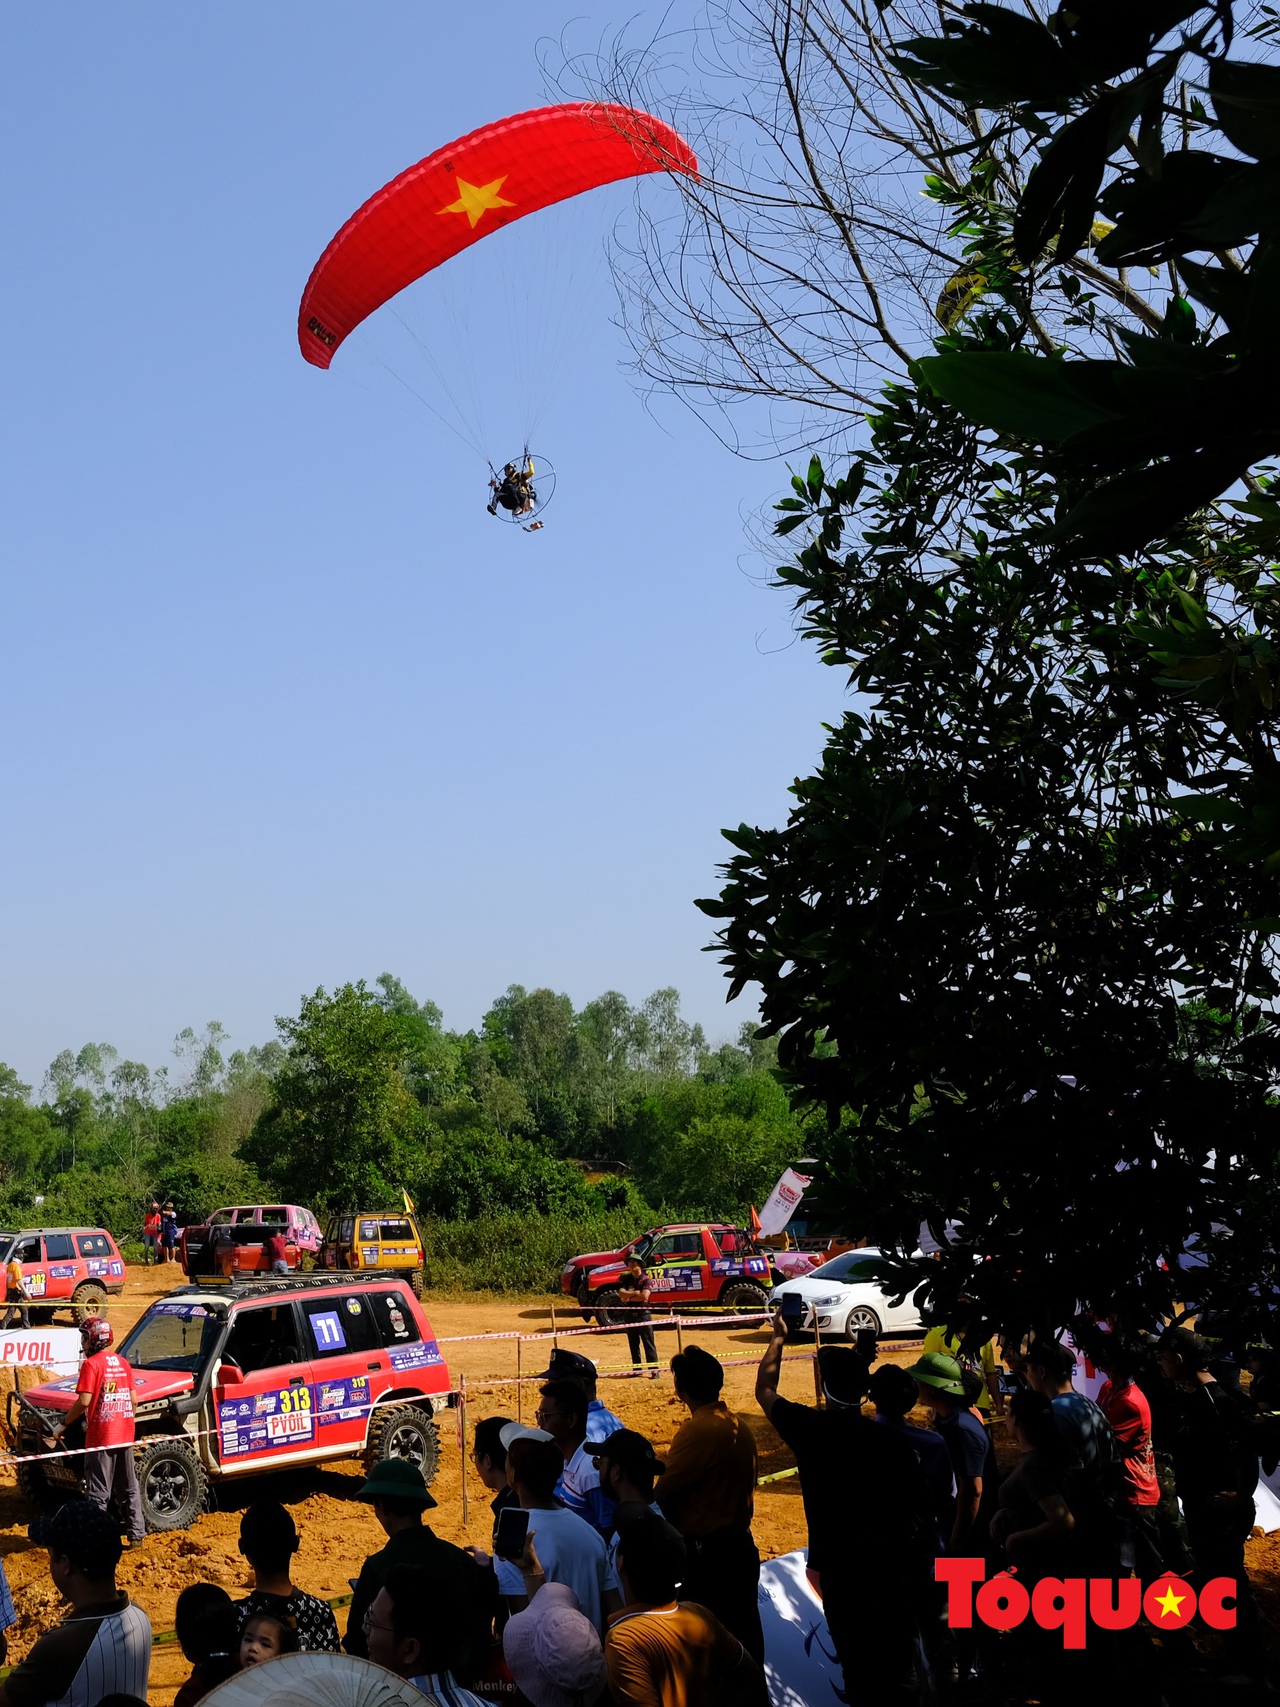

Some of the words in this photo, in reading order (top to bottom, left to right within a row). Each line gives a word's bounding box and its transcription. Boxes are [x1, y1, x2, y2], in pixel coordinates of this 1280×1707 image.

[32, 1273, 46, 1284] 302
[646, 1269, 664, 1279] 312
[3, 1342, 54, 1361] PVOIL
[352, 1377, 366, 1388] 313
[279, 1387, 311, 1413] 313
[221, 1406, 237, 1417] Ford
[271, 1412, 307, 1436] PVOIL
